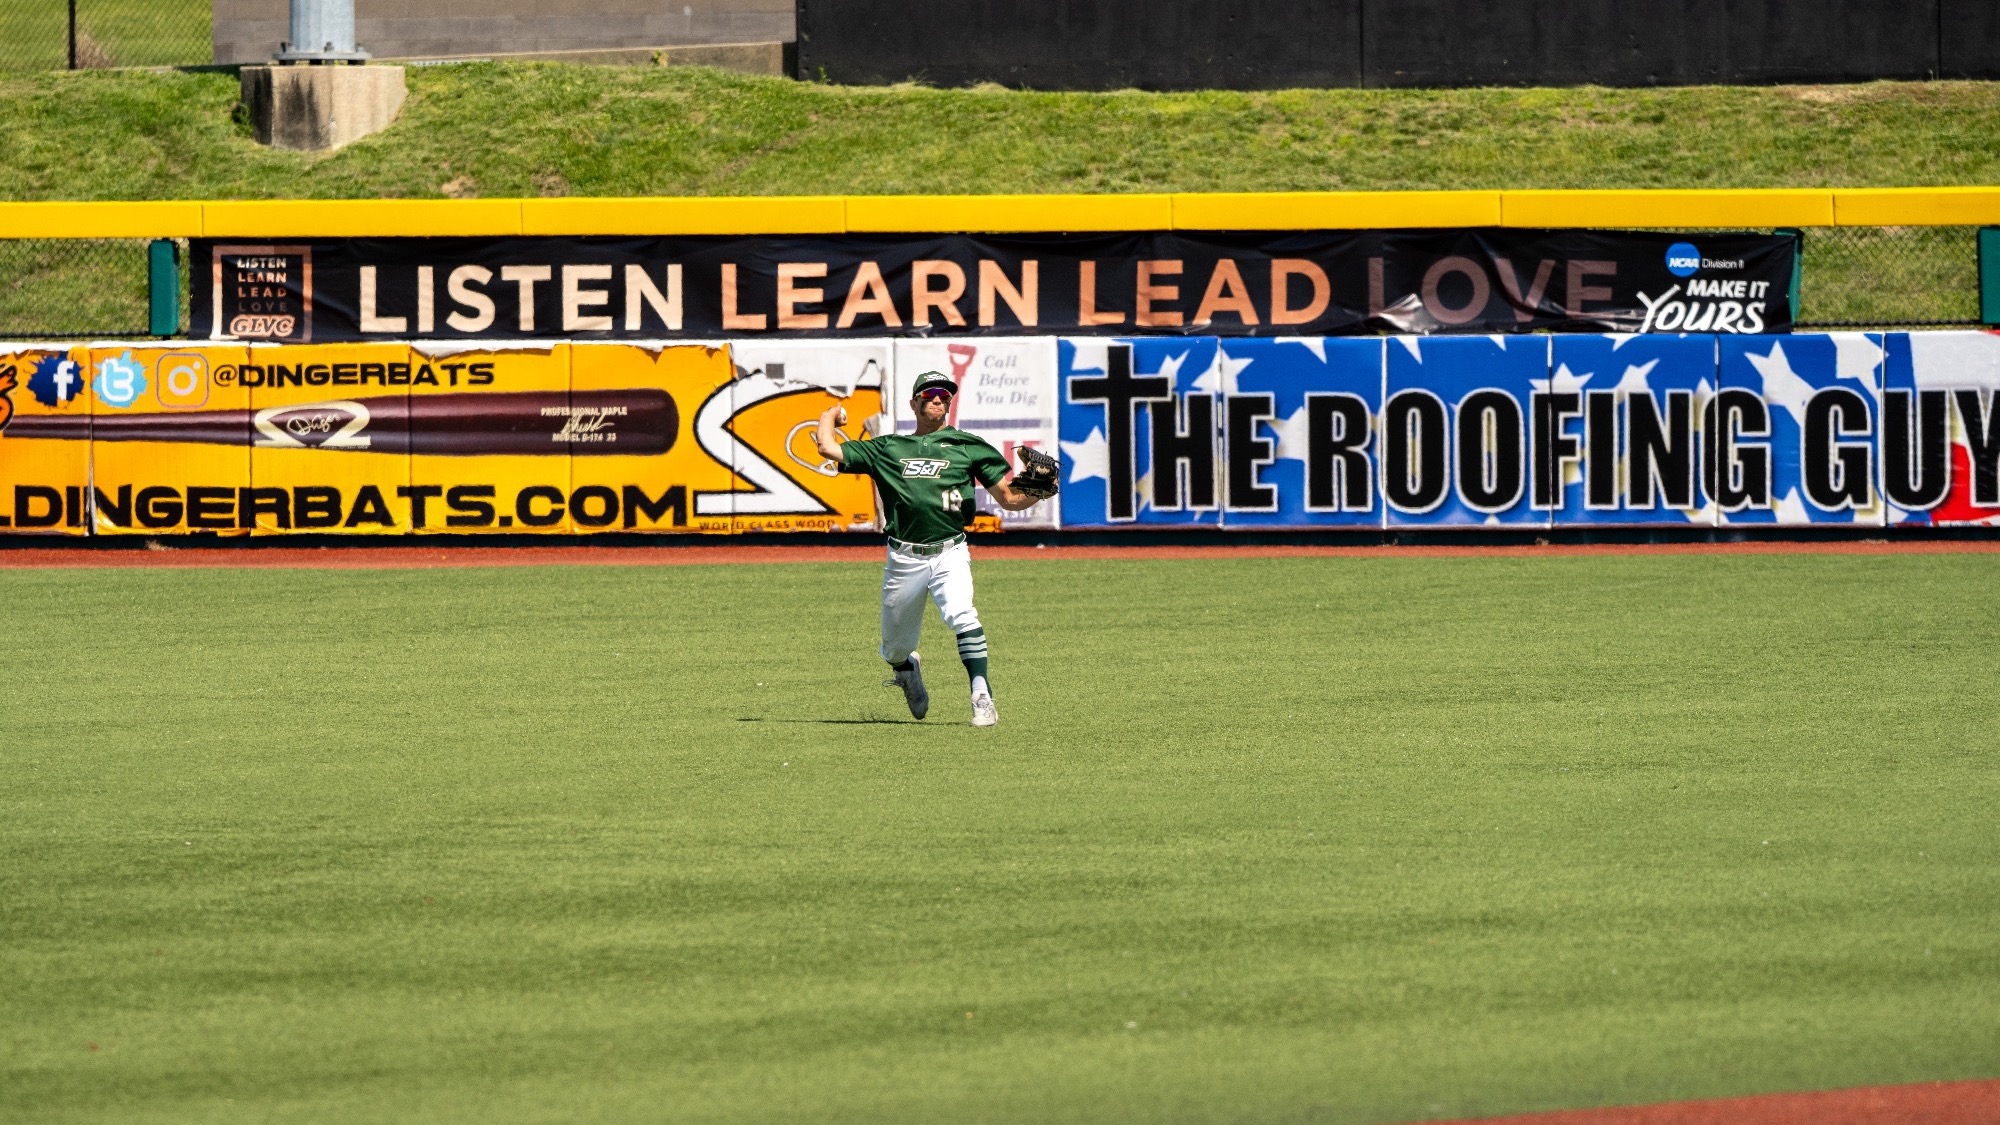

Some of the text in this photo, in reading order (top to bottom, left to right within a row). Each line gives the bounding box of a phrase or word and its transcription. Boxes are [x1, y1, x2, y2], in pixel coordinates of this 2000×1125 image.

[237, 257, 287, 268] LISTEN
[1668, 257, 1699, 268] NCAA
[1702, 258, 1737, 269] Division
[237, 271, 287, 282] LEARN
[238, 286, 287, 297] LEAD
[360, 256, 1617, 334] LISTEN LEARN LEAD LOVE
[1686, 278, 1770, 299] MAKE IT
[238, 301, 288, 313] LOVE
[1635, 283, 1767, 335] YOURS
[230, 314, 295, 336] GLVC
[984, 354, 1018, 369] Call
[213, 362, 495, 388] @DINGERBATS
[979, 374, 1031, 388] Before
[976, 391, 1039, 407] You Dig
[1304, 386, 1772, 514] ROOFING
[900, 458, 950, 479] S&T
